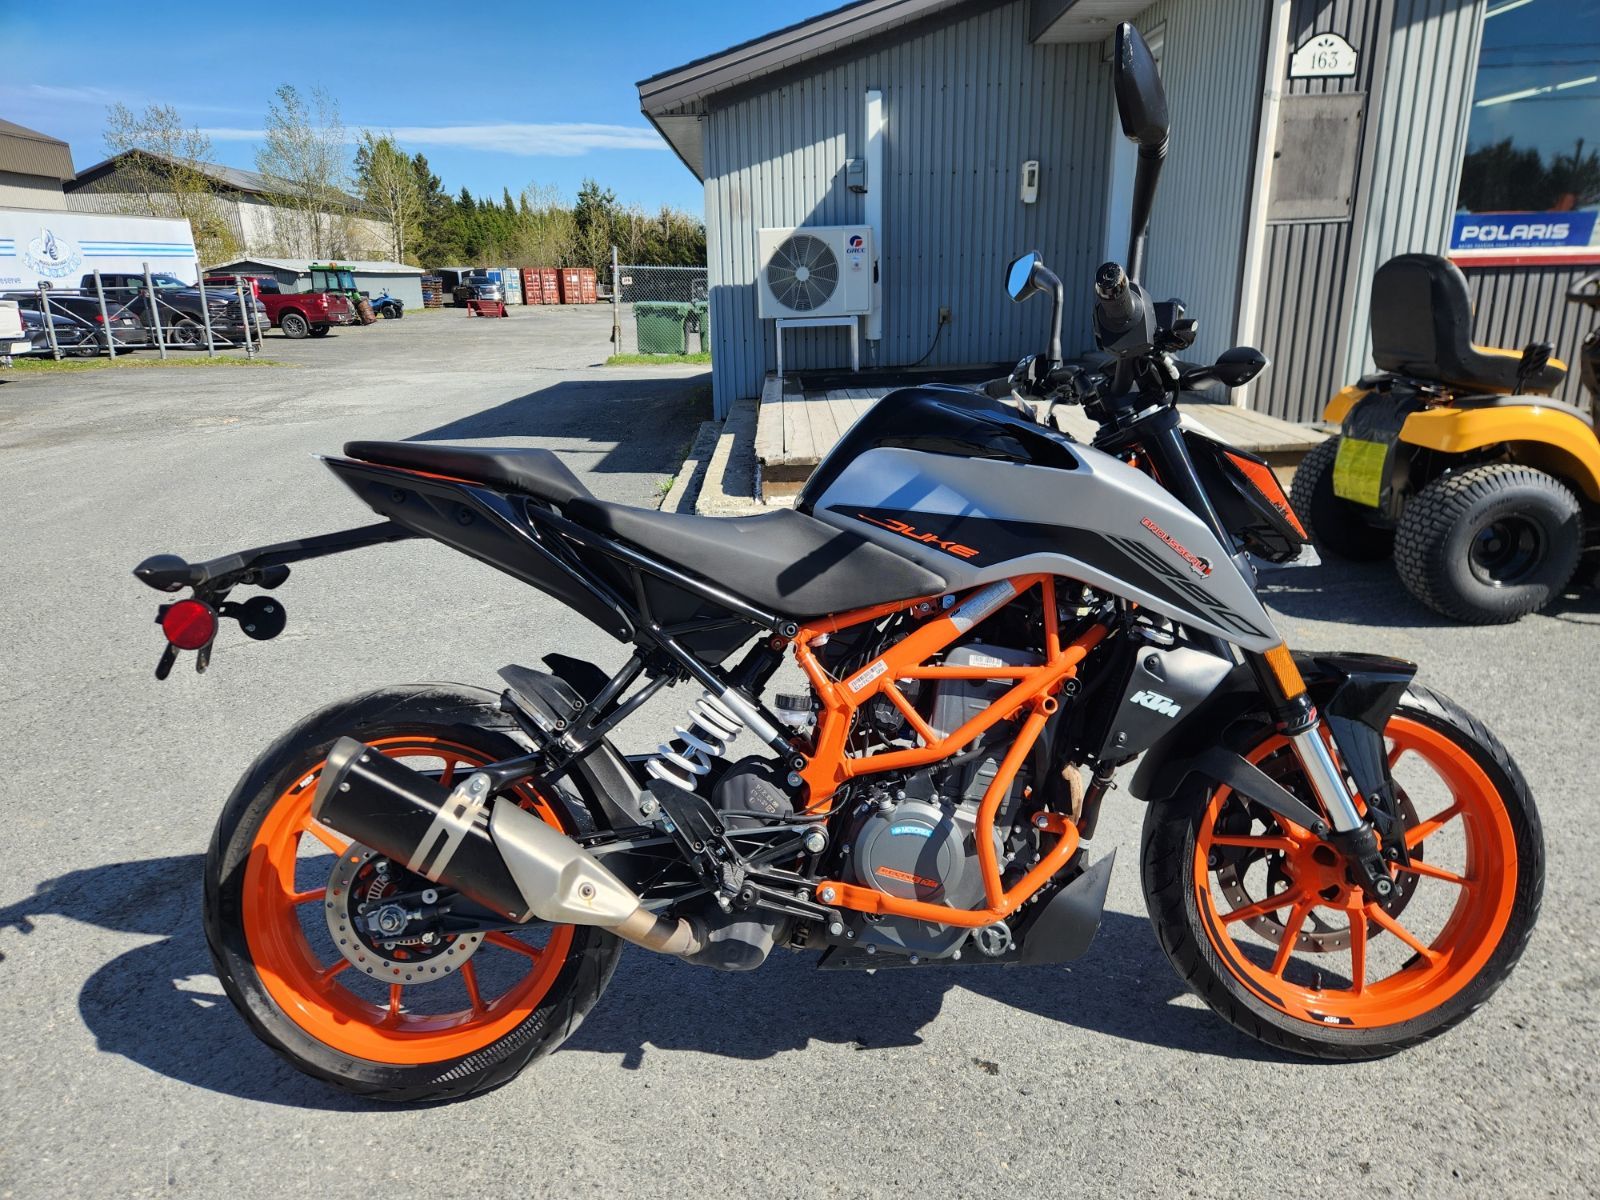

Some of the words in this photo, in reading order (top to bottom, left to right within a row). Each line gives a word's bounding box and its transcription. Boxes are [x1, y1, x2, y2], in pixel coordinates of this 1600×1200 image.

[1310, 51, 1339, 70] 163
[1460, 223, 1570, 242] POLARIS
[857, 513, 980, 559] DUKE
[1129, 689, 1182, 718] KTM
